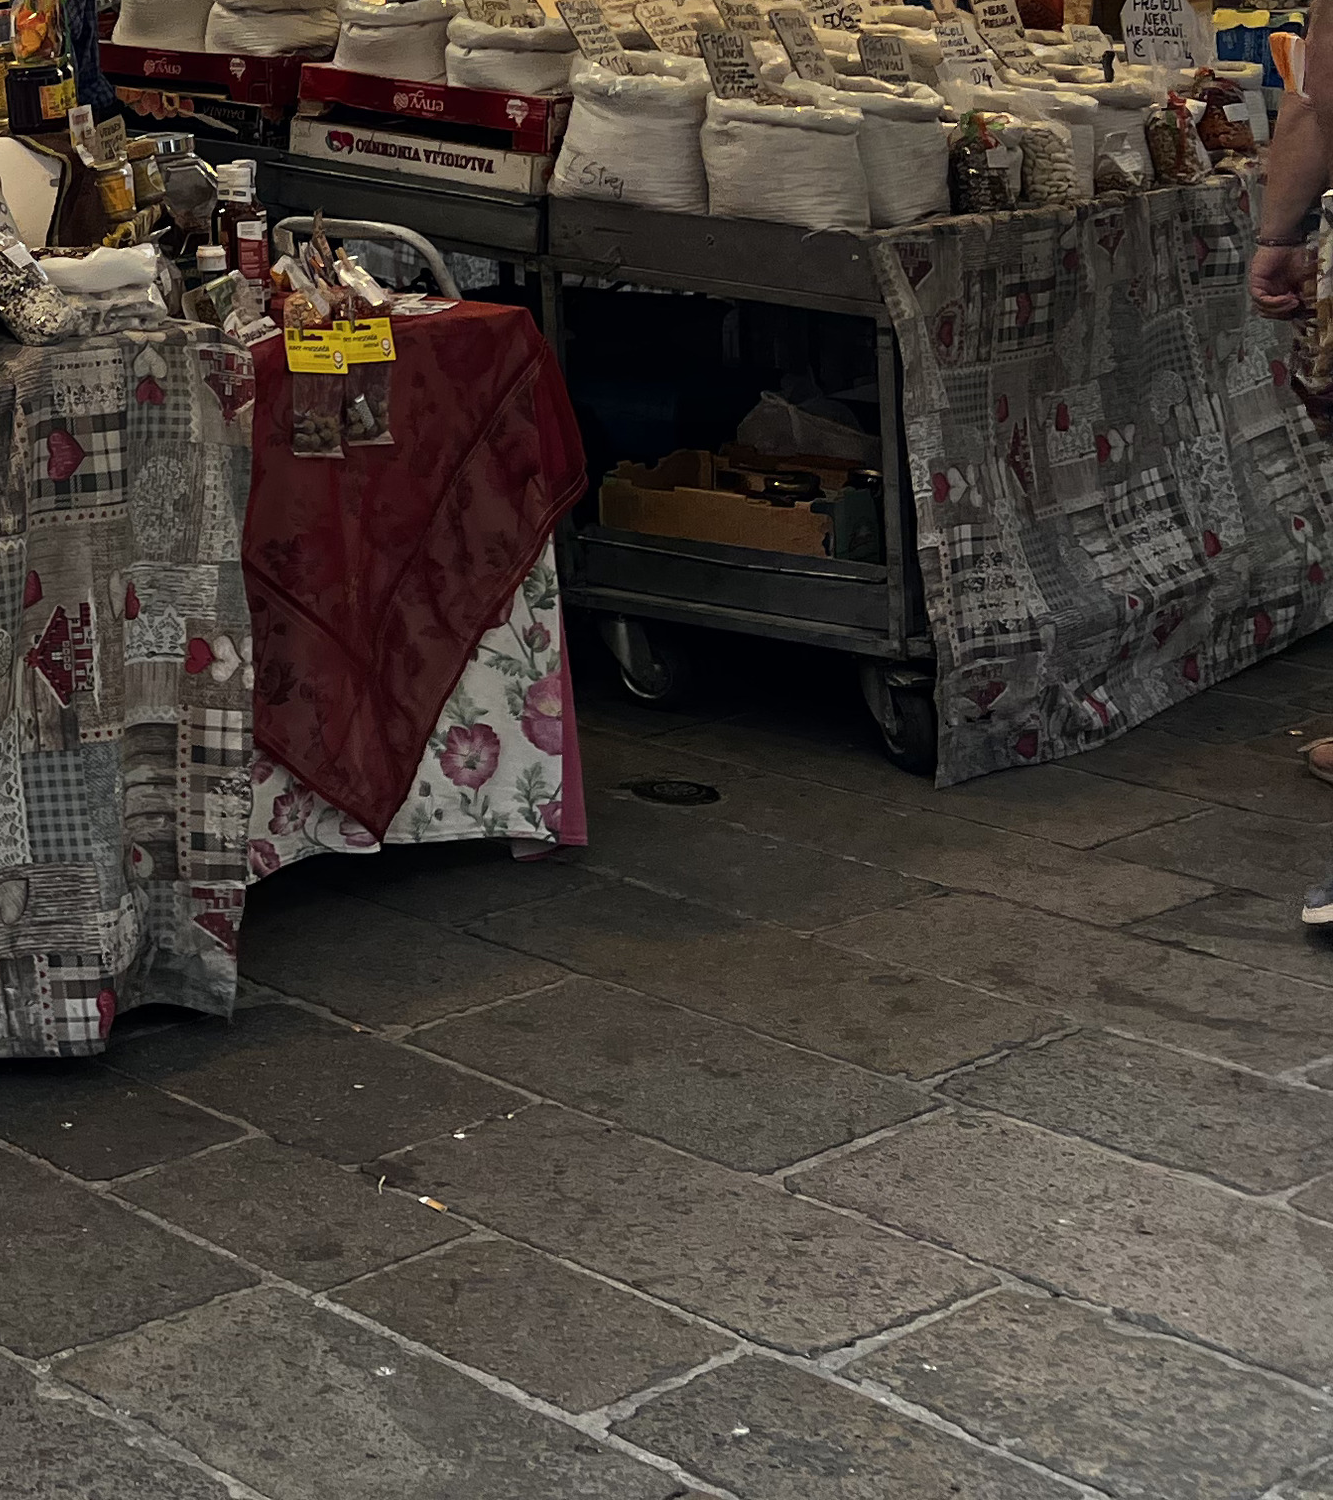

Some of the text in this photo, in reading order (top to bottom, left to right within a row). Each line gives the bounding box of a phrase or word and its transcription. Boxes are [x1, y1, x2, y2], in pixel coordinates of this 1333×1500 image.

[1143, 12, 1173, 26] NERI
[408, 89, 443, 111] envy
[355, 138, 422, 162] VINCENZO
